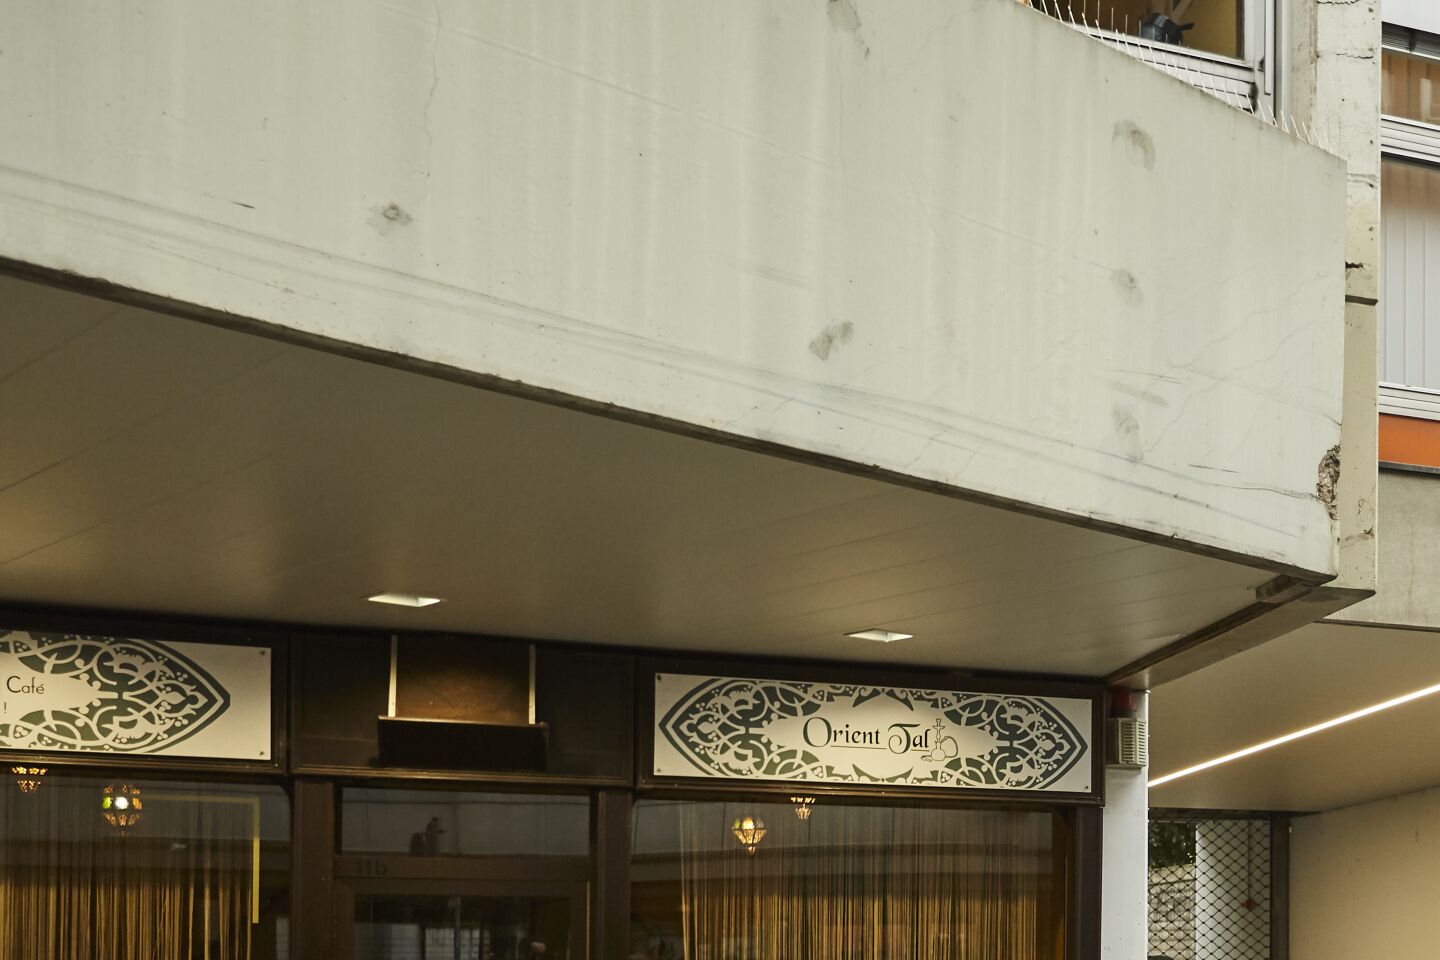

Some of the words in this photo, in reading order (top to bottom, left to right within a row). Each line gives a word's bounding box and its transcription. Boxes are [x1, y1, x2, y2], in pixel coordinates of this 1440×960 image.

[6, 675, 45, 695] Café
[802, 716, 880, 748] Orient
[887, 723, 931, 755] Tal
